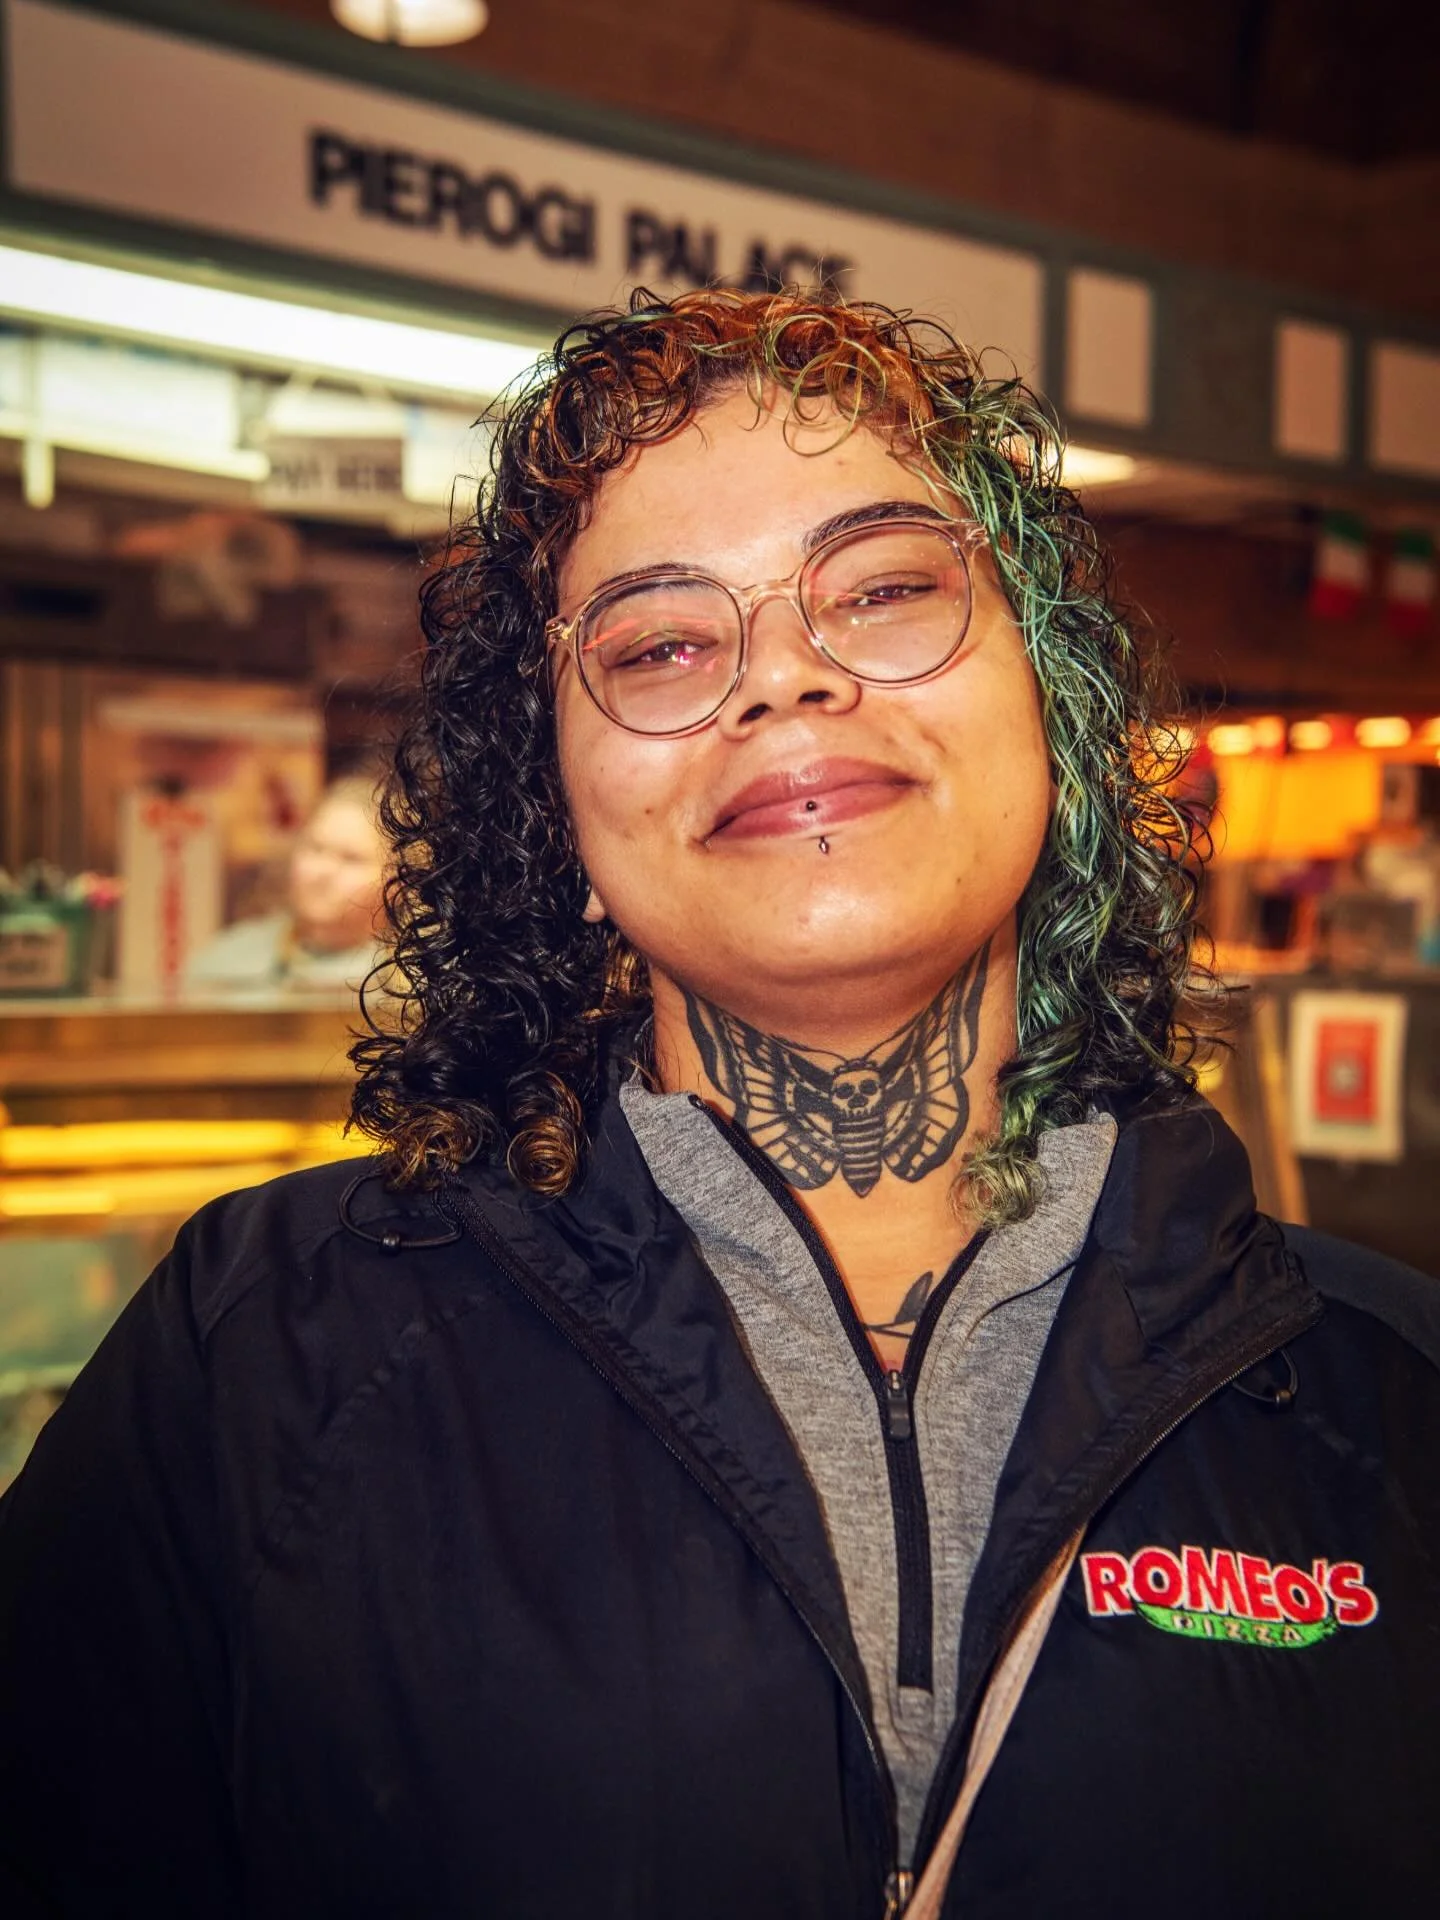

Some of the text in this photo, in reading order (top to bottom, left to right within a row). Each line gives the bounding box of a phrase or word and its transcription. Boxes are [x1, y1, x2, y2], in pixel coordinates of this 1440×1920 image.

[309, 130, 596, 262] PIEROGI
[1081, 1545, 1378, 1625] ROMEO'S
[1172, 1614, 1303, 1644] PIZZA
